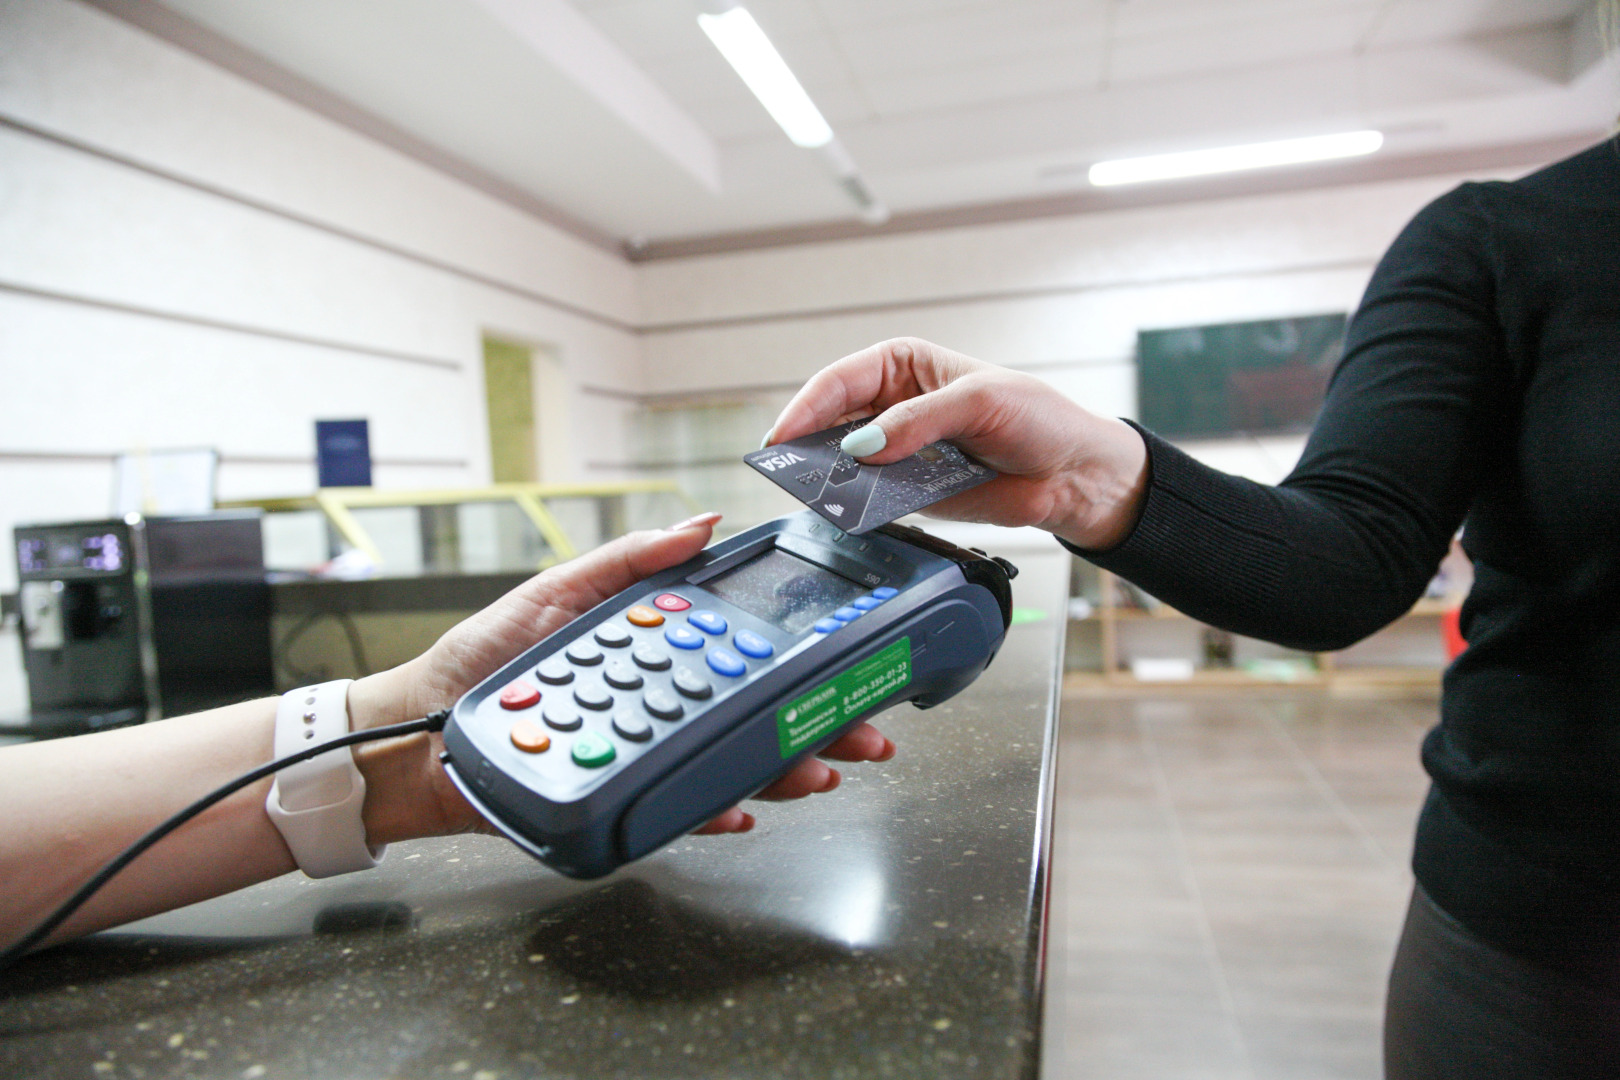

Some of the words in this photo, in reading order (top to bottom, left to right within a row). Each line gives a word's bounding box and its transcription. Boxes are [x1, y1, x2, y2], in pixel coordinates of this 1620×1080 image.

[757, 452, 807, 472] VISA
[923, 471, 973, 493] СБЕРБАНК
[865, 573, 881, 585] S90
